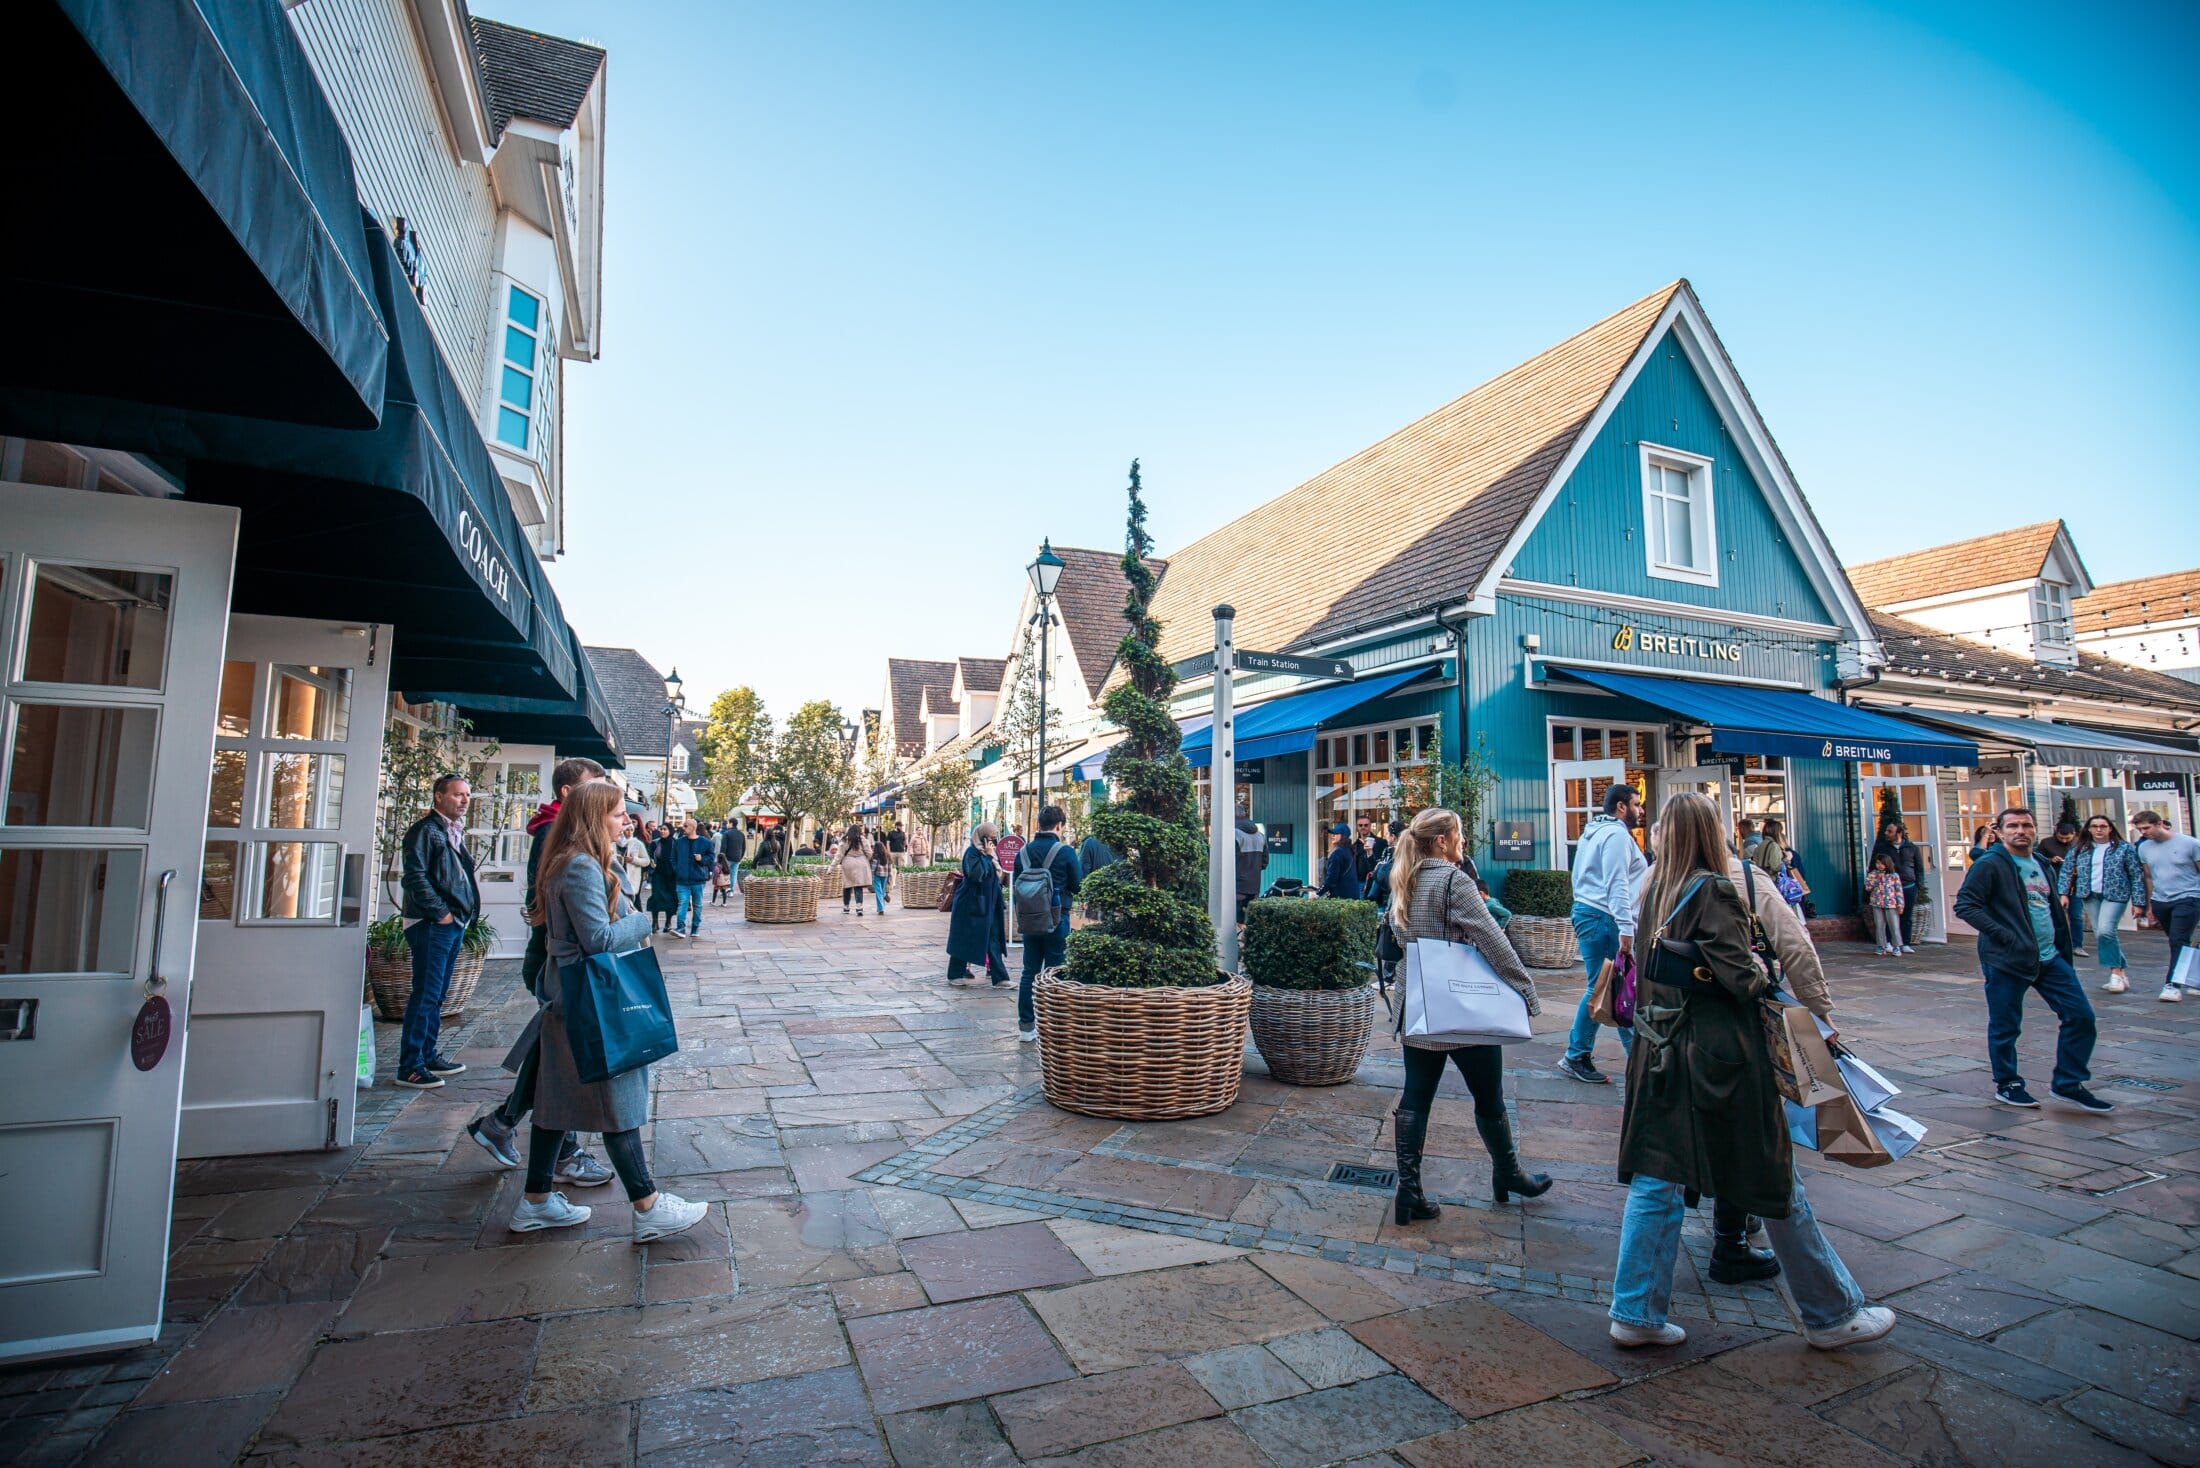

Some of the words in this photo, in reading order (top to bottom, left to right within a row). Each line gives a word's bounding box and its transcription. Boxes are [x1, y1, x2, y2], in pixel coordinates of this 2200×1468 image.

[460, 510, 509, 602] COACH
[1640, 633, 1740, 661] BREITLING
[1248, 656, 1269, 667] Train
[1271, 658, 1300, 670] Station
[1835, 745, 1891, 760] BREITLING
[1701, 757, 1739, 765] BREITLING
[2143, 781, 2176, 790] GANNI
[136, 1017, 165, 1044] SALE
